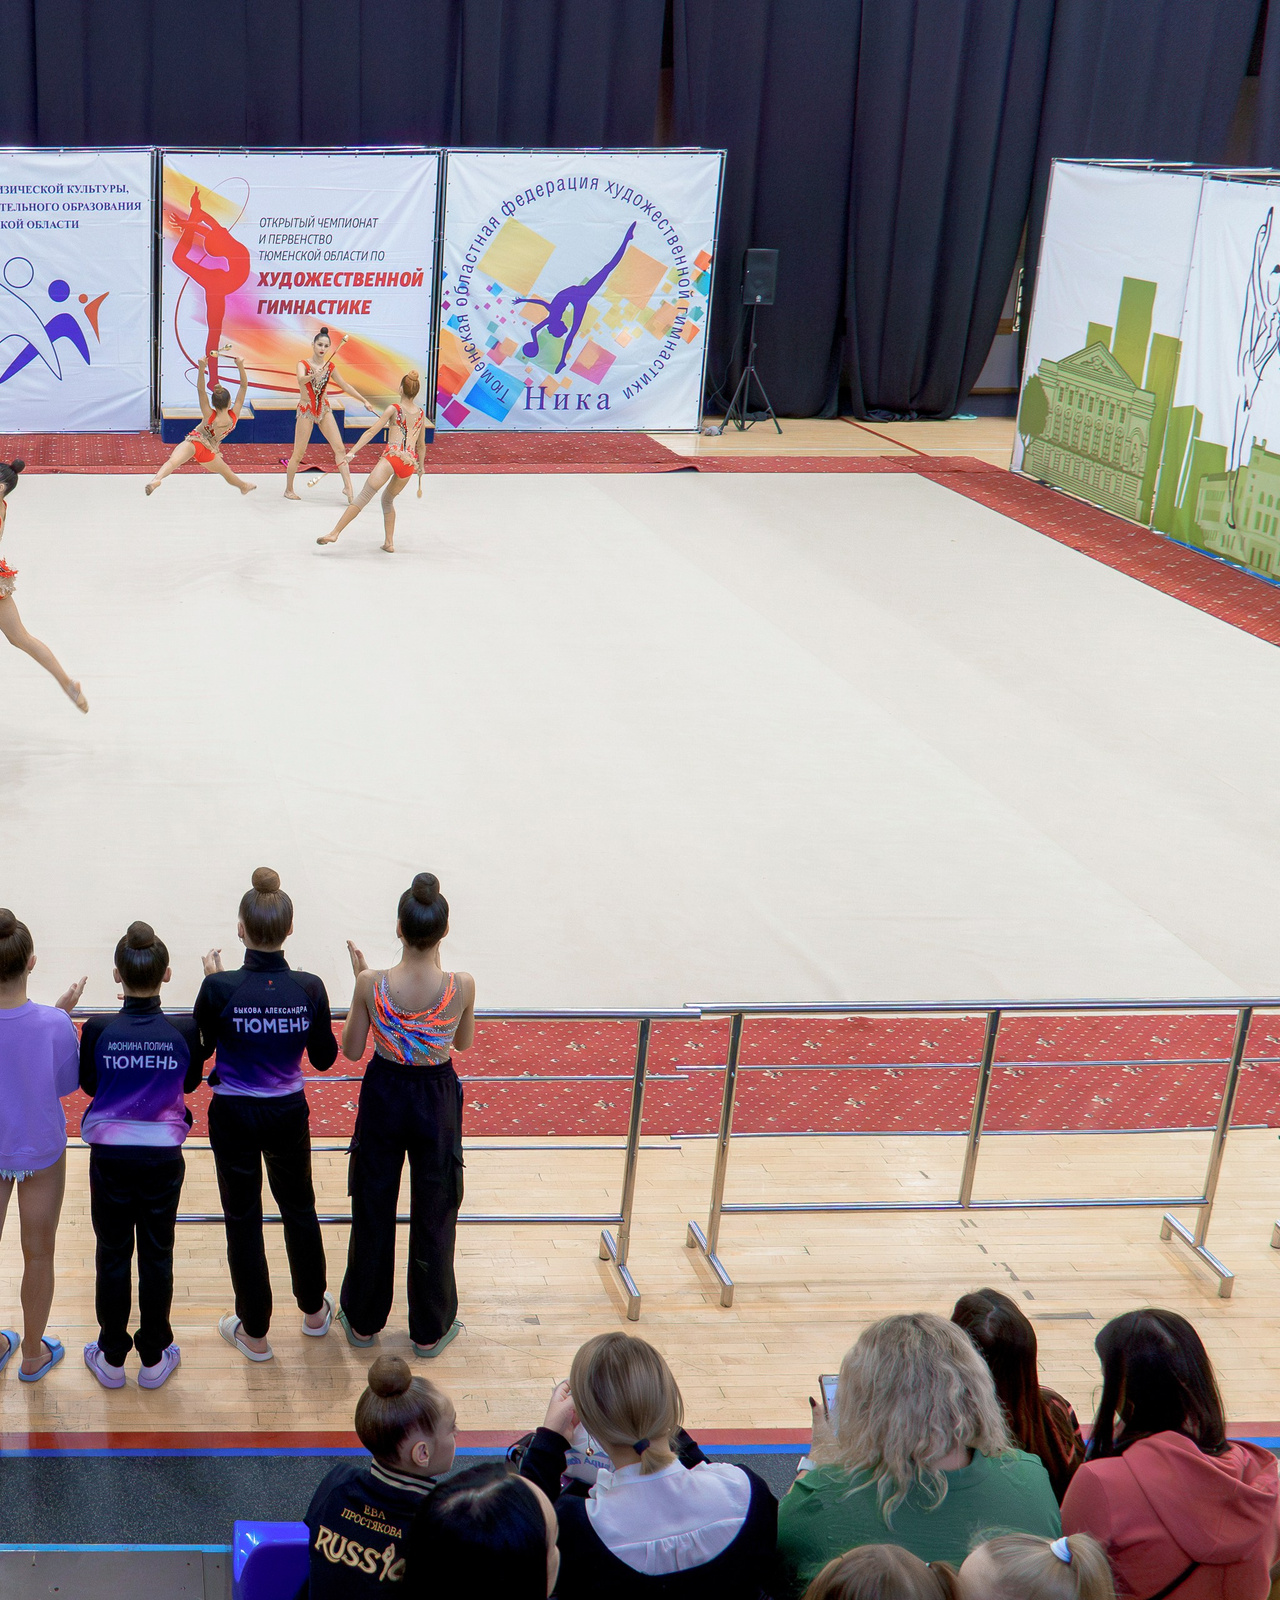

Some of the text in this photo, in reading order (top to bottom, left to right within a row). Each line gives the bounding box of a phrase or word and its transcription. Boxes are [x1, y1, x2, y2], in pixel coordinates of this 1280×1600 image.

[67, 184, 129, 196] КУЛЬТУРЫ,
[62, 202, 142, 212] ОБРАЗОВАНИЯ
[26, 220, 79, 229] ОБЛАСТИ
[259, 216, 378, 228] ОТКРЫТЫЙ ЧЕМПИОНАТ
[258, 234, 333, 245] И ПЕРВЕНСТВО
[259, 249, 385, 261] ТЮМЕНСКОЙ ОБЛАСТИ ПО
[257, 268, 424, 289] ХУДОЖЕСТВЕННОЙ
[453, 176, 696, 405] Тюменская областная федерация художественной гимнастики
[257, 299, 372, 315] ГИМНАСТИКЕ
[523, 386, 611, 411] Ника
[233, 1005, 308, 1014] БЫКОВА АЛЕКСАНДРА
[233, 1017, 310, 1034] ТЮМЕНЬ
[108, 1041, 173, 1051] АФОНИНА ПОЛИНА
[103, 1056, 178, 1070] ТЮМЕНЬ
[363, 1505, 386, 1520] ЕВА
[340, 1507, 402, 1539] ПРОСТЯКОВА
